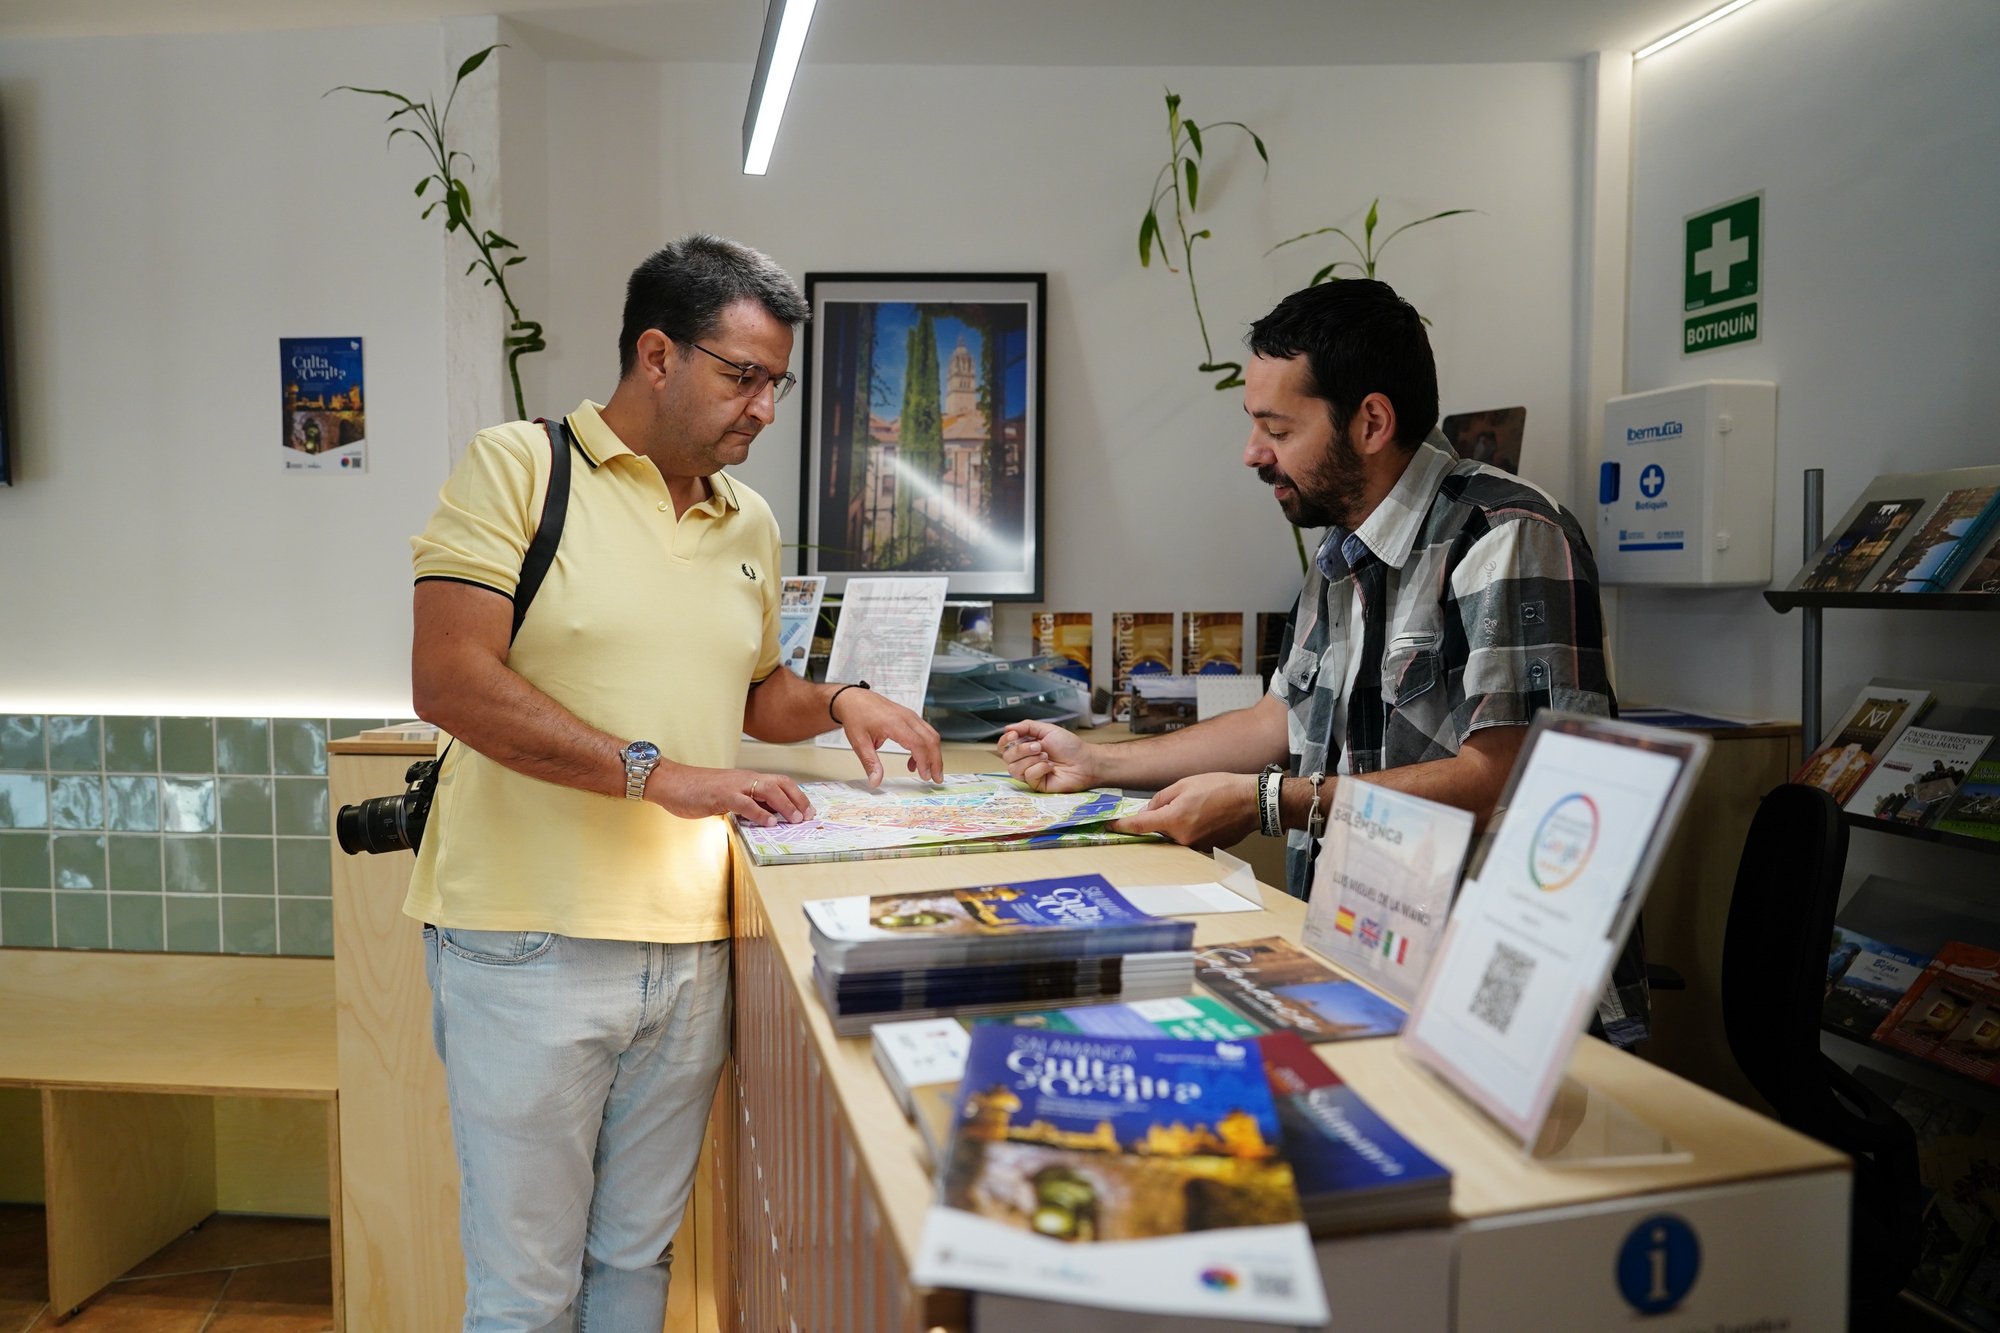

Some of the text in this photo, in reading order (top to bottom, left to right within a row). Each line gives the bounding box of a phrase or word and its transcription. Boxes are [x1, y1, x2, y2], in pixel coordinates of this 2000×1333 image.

[1686, 312, 1755, 346] BOTIQUÍN
[292, 354, 329, 369] Culta
[303, 367, 346, 380] Oculta
[1903, 736, 1921, 746] POR
[1920, 739, 1967, 752] SALAMANCA
[1907, 730, 1986, 746] PASEOS TURÍSTICOS
[1006, 1050, 1136, 1083] Culta
[1039, 1074, 1202, 1104] Oculta
